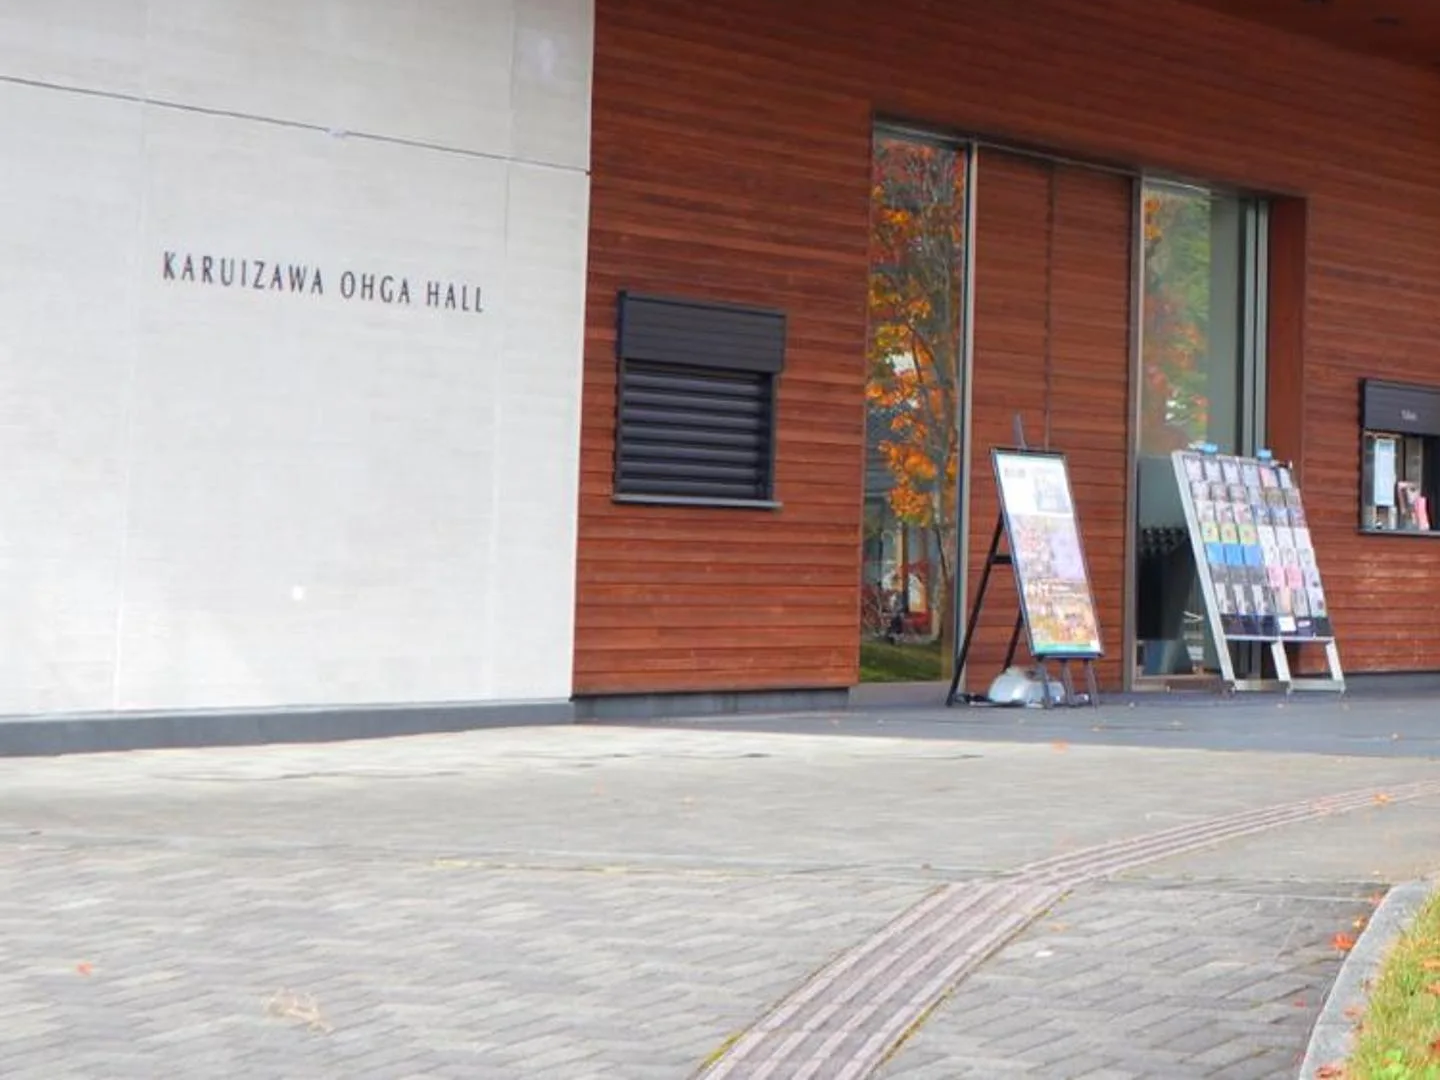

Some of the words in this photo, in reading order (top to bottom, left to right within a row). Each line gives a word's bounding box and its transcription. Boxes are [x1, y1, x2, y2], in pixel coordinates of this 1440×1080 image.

[162, 250, 325, 296] KARUIZAWA
[339, 270, 412, 306] OHGA
[426, 281, 484, 314] HALL
